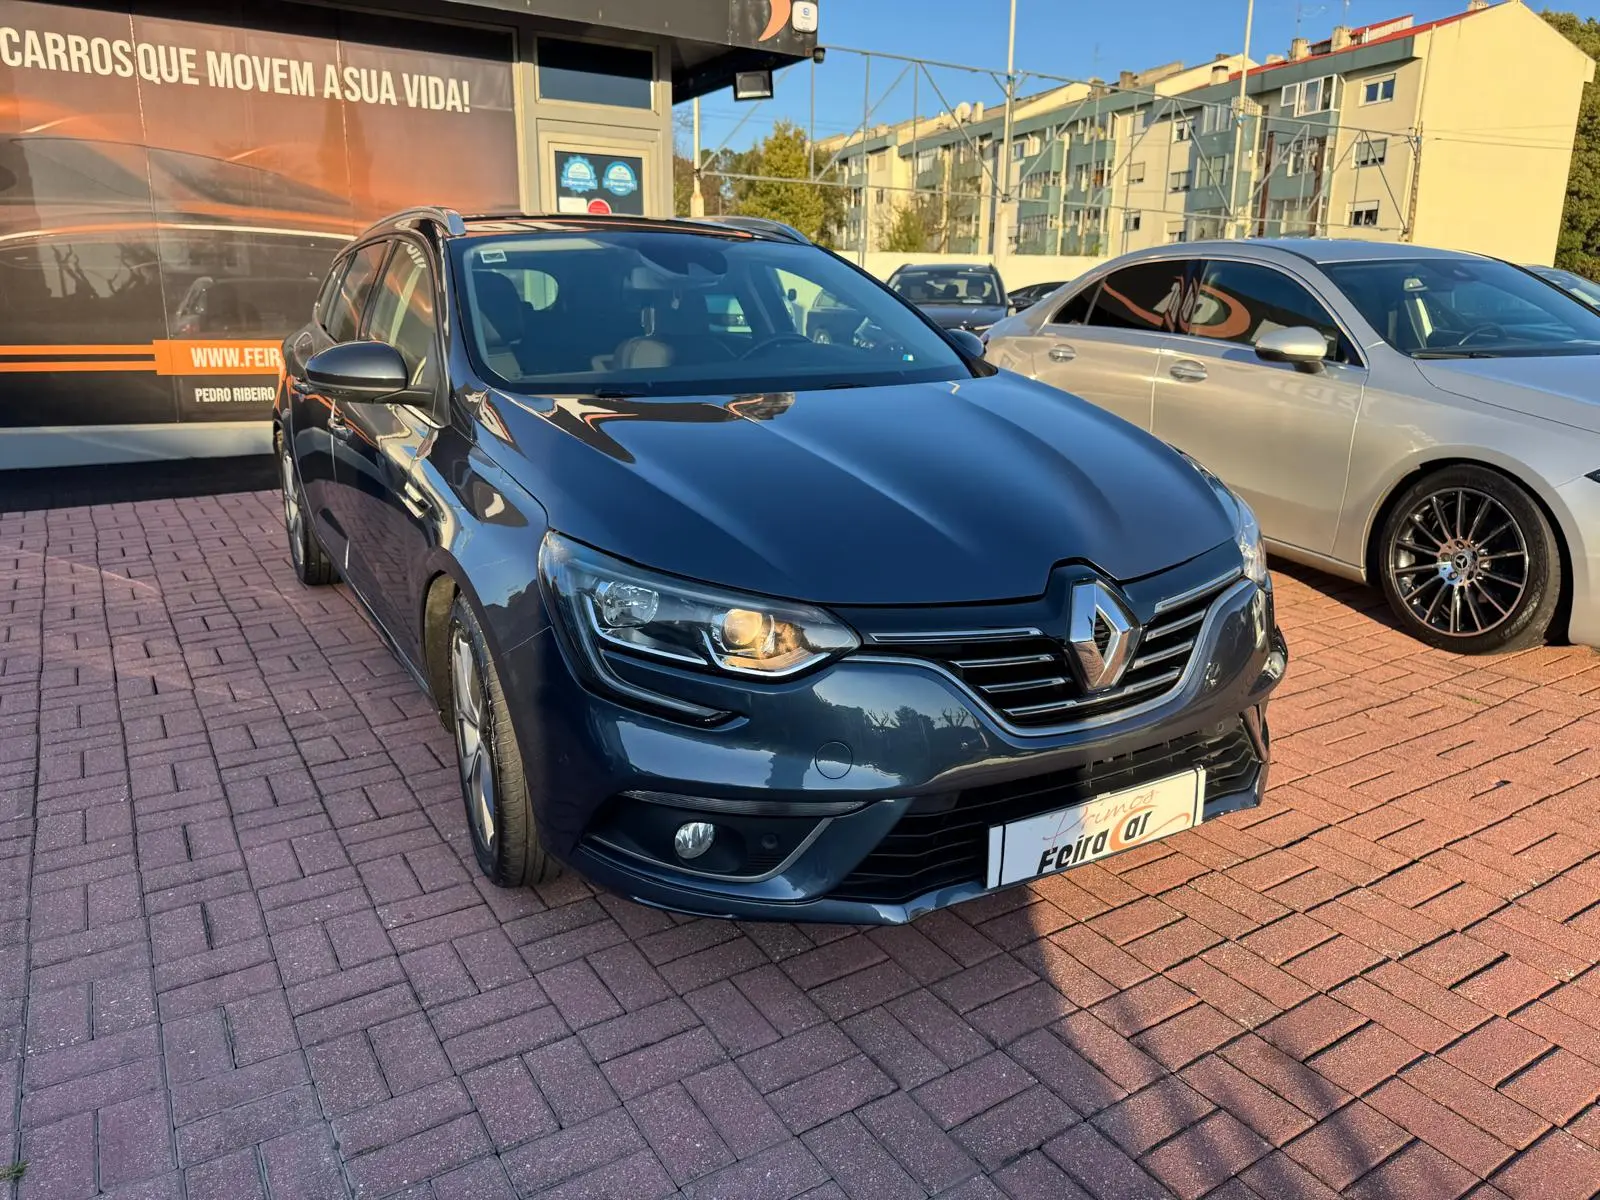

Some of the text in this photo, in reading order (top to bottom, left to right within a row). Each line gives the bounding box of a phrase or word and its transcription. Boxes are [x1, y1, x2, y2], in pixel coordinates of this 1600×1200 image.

[0, 27, 471, 113] CARROS QUE MOVEM A SUA VIDA!
[194, 386, 276, 402] PEDRO RIBEIRO
